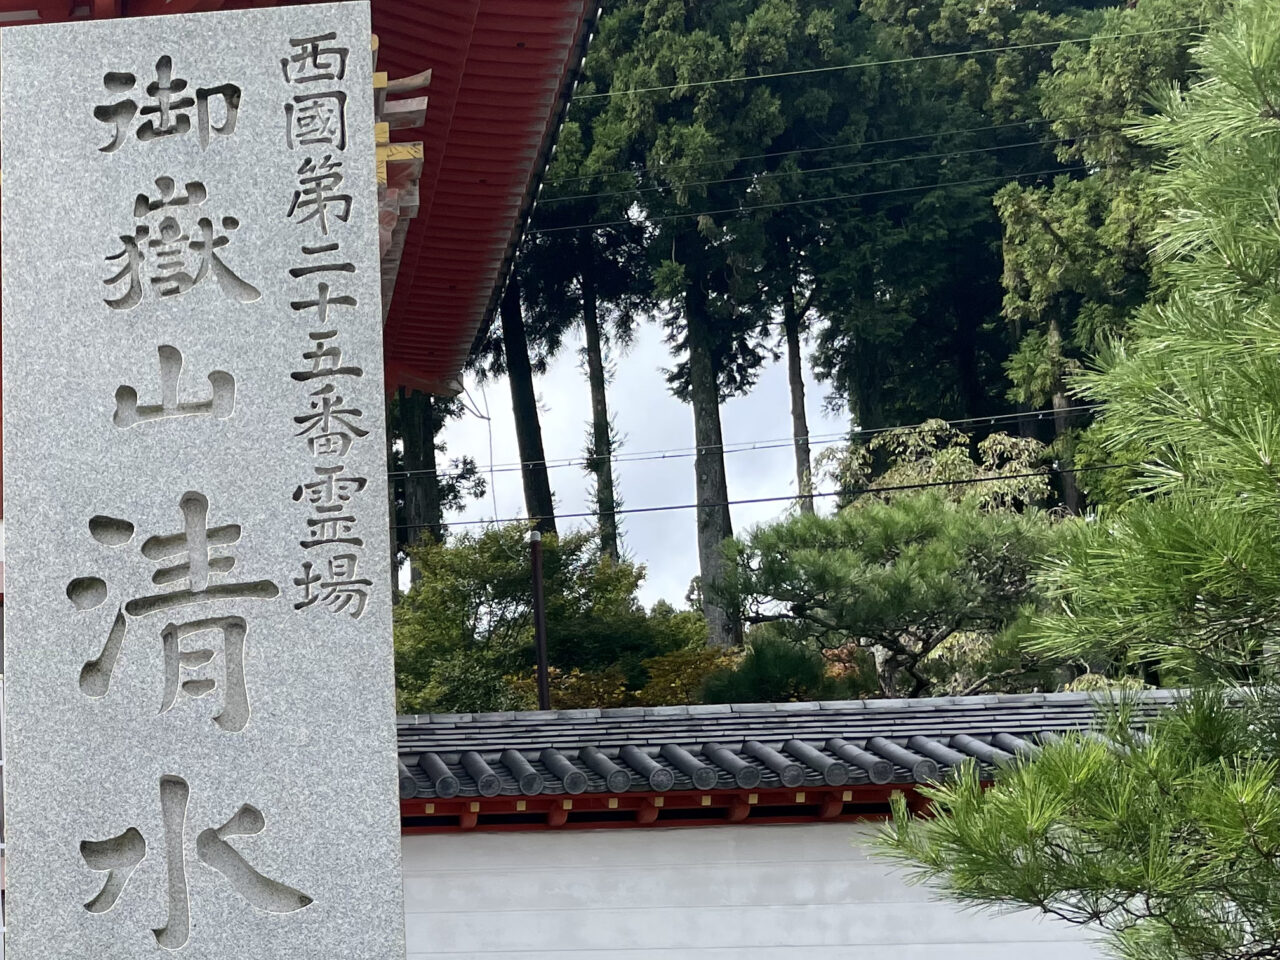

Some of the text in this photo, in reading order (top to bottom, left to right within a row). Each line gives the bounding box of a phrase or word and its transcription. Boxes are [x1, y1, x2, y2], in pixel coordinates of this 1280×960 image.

[279, 31, 373, 620] 西國第二十五番霊場
